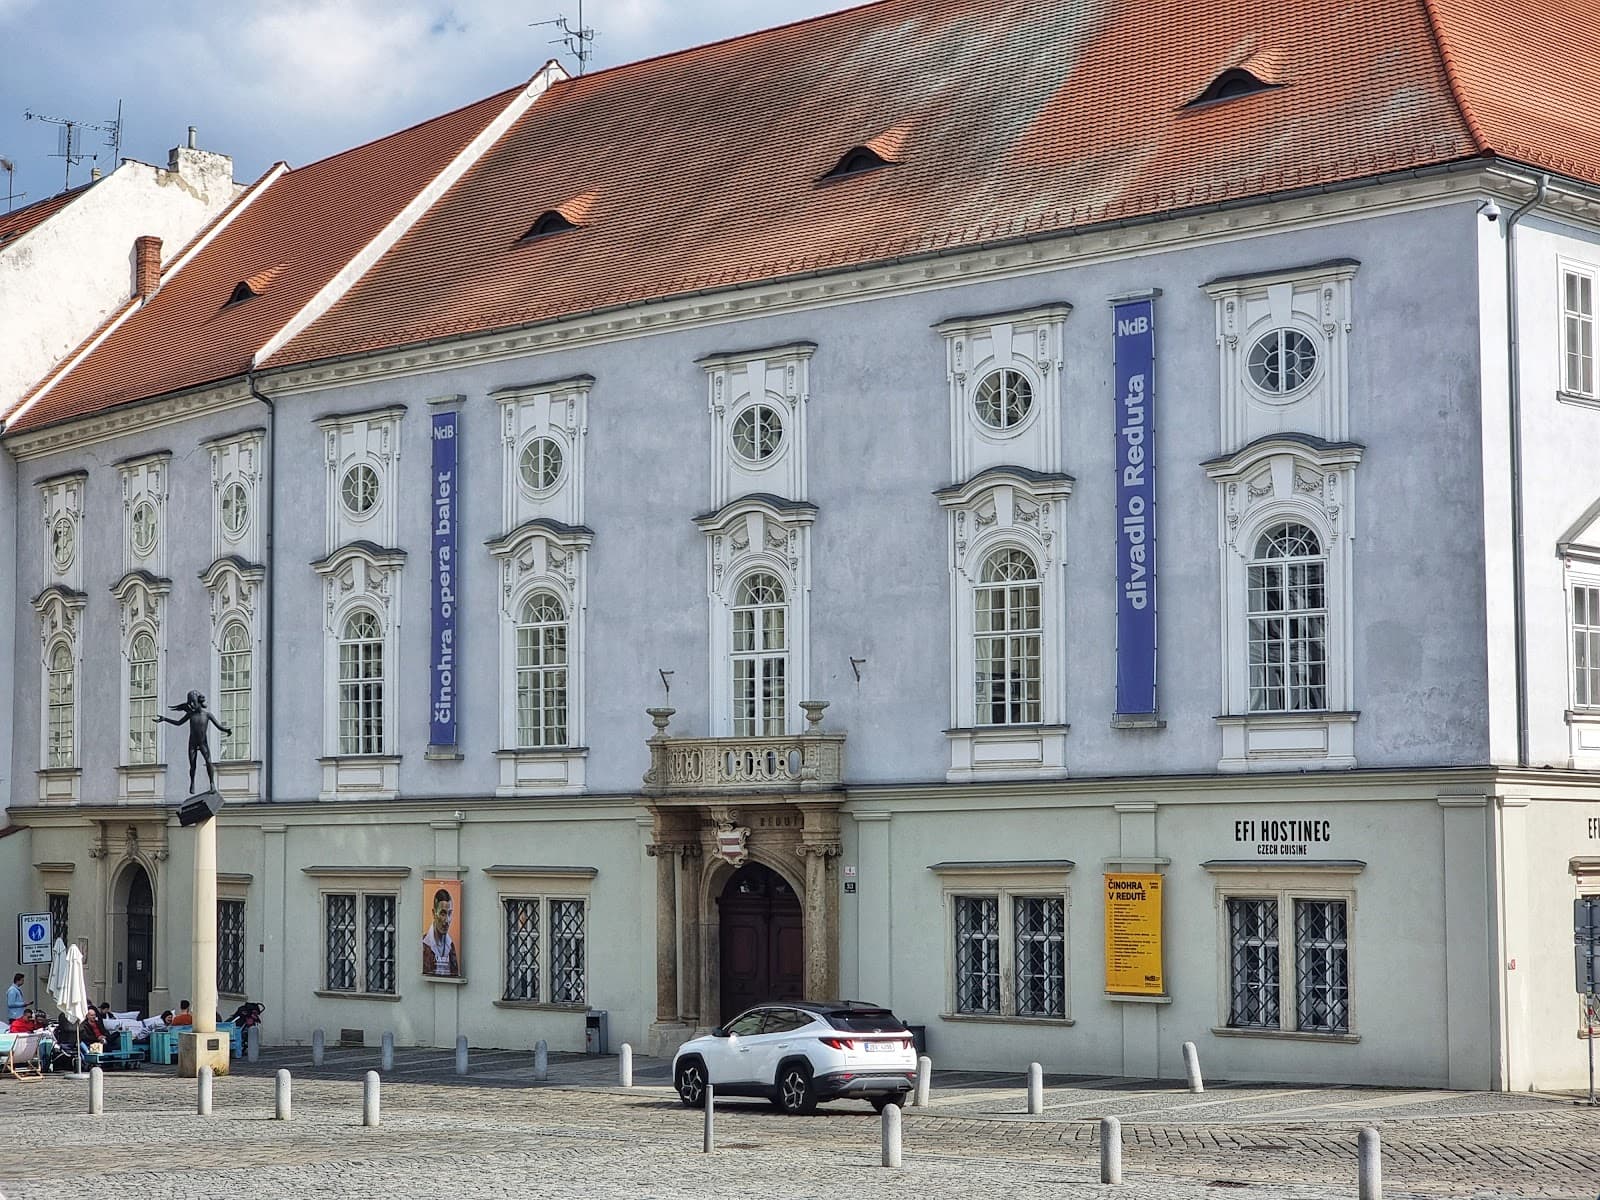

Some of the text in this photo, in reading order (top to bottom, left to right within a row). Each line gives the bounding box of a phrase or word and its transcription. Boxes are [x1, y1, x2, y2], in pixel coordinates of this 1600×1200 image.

[1118, 316, 1148, 336] NdB
[434, 425, 454, 440] NdB
[1122, 374, 1147, 610] divadlo Reduta
[434, 471, 454, 723] činohra opera balet
[1235, 820, 1330, 842] EFI HOSTINEC
[1257, 844, 1307, 856] CZECH CUISINE
[1108, 879, 1143, 890] ČINOHRA
[1108, 890, 1147, 901] V REDUTĚ
